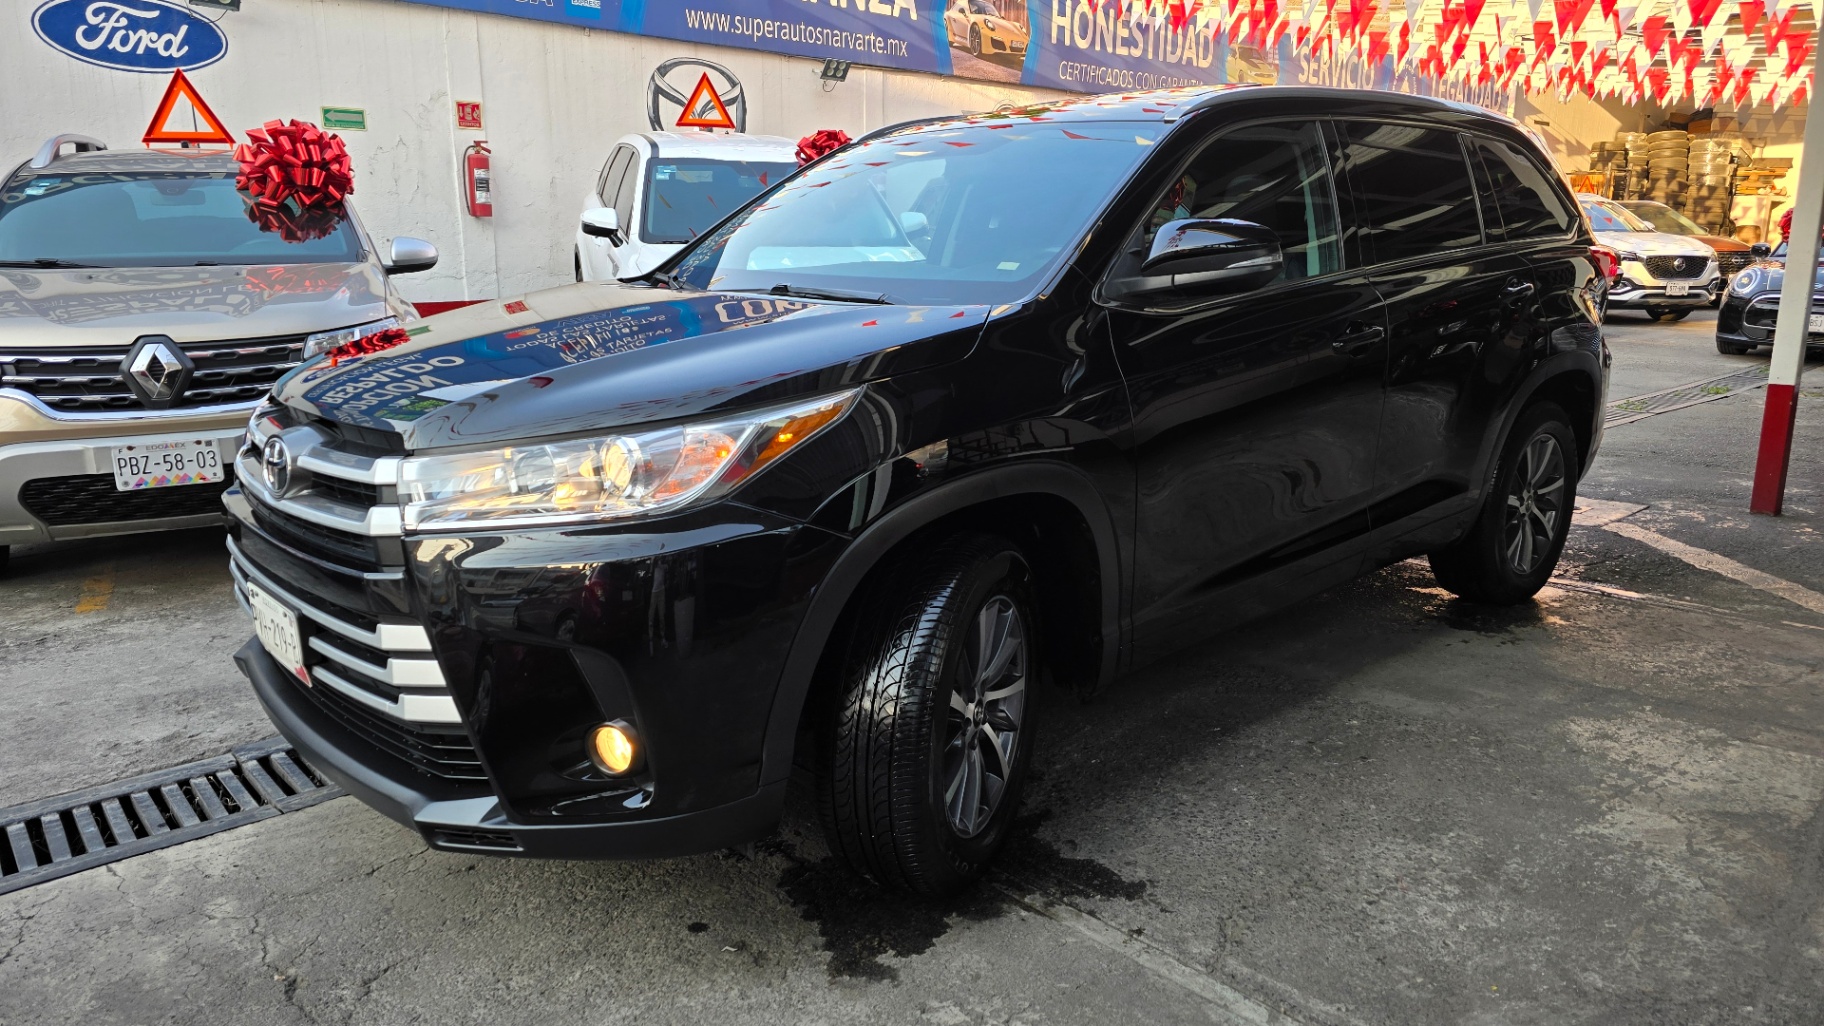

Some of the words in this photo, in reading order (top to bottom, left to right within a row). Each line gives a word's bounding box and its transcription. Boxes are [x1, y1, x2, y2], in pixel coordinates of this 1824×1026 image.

[76, 2, 189, 58] Ford
[685, 9, 908, 57] www.superautosnarvarte.mx
[1051, 0, 1214, 68] HONESTIDAD
[1059, 60, 1134, 89] CERTIFICADOS
[1135, 72, 1158, 90] CON
[117, 450, 217, 477] PBZ-58-03
